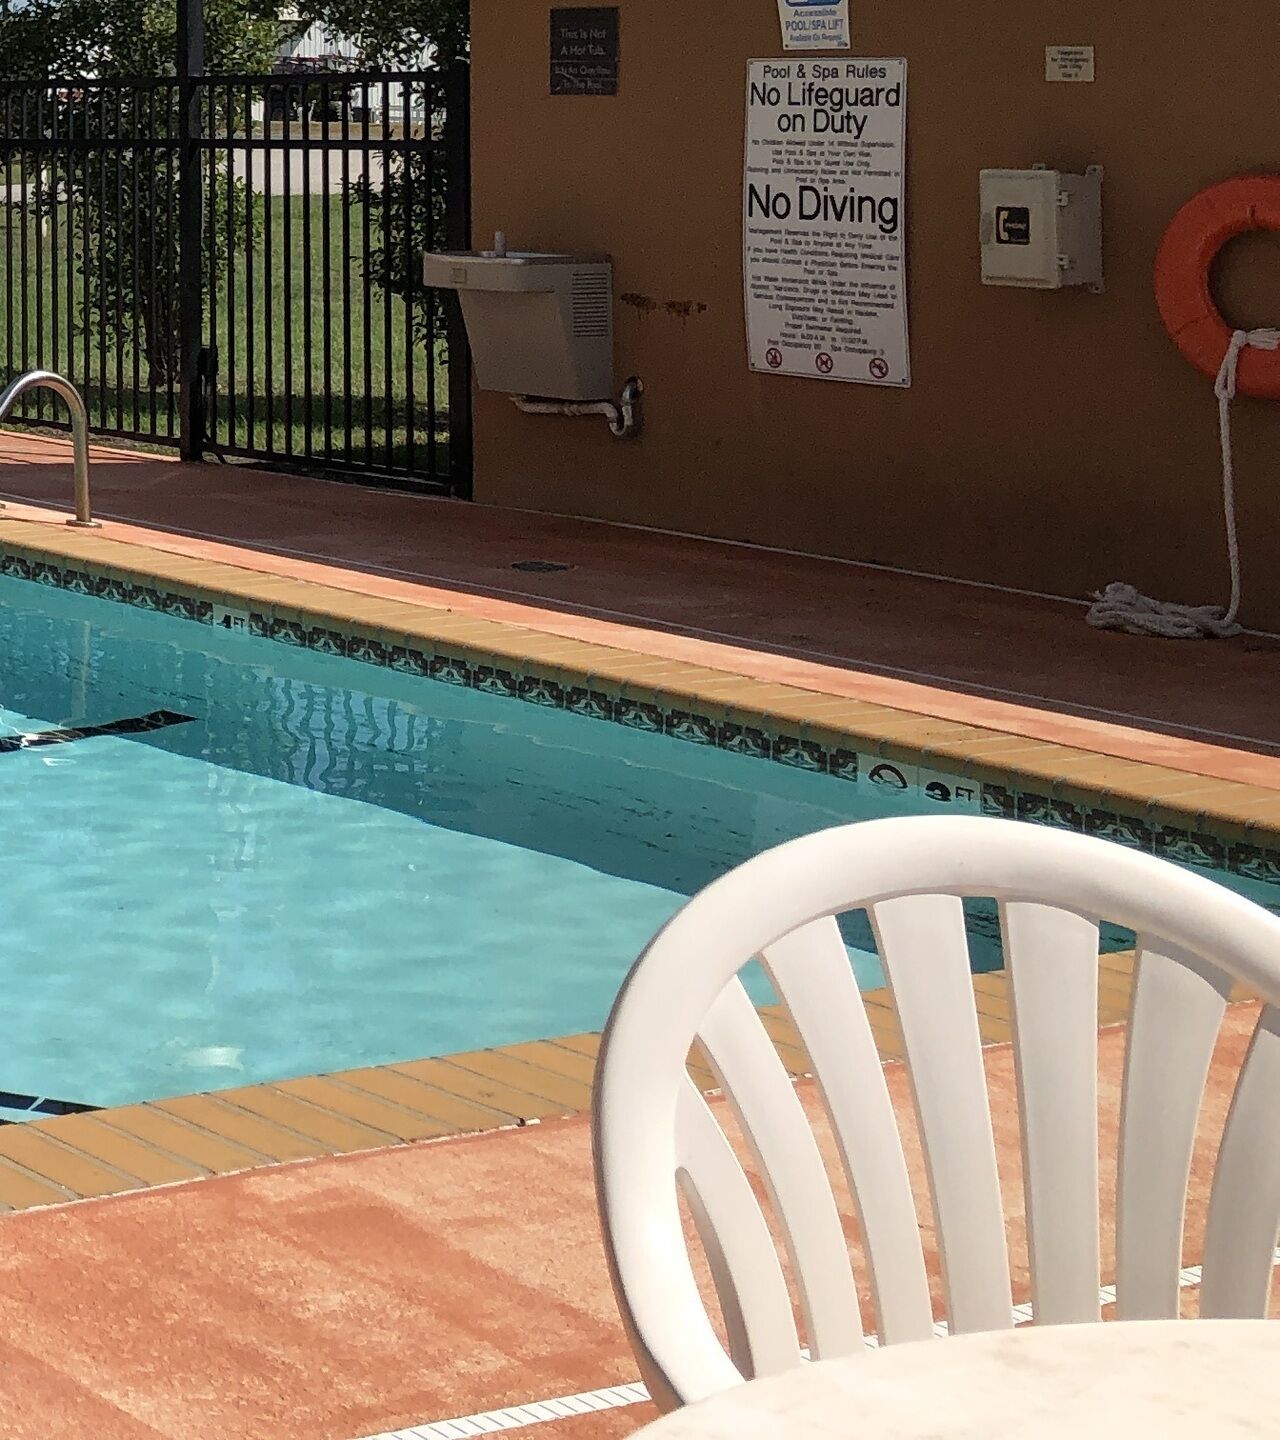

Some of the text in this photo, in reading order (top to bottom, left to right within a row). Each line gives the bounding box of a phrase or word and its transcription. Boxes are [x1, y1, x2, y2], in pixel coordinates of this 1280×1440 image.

[590, 28, 607, 39] Not
[785, 20, 827, 31] POOL/SPA
[763, 64, 887, 81] Pool & Spa Rules
[750, 82, 901, 112] No Lifeguard
[777, 109, 868, 139] on Duty
[748, 184, 899, 234] No Diving
[955, 786, 975, 802] FT
